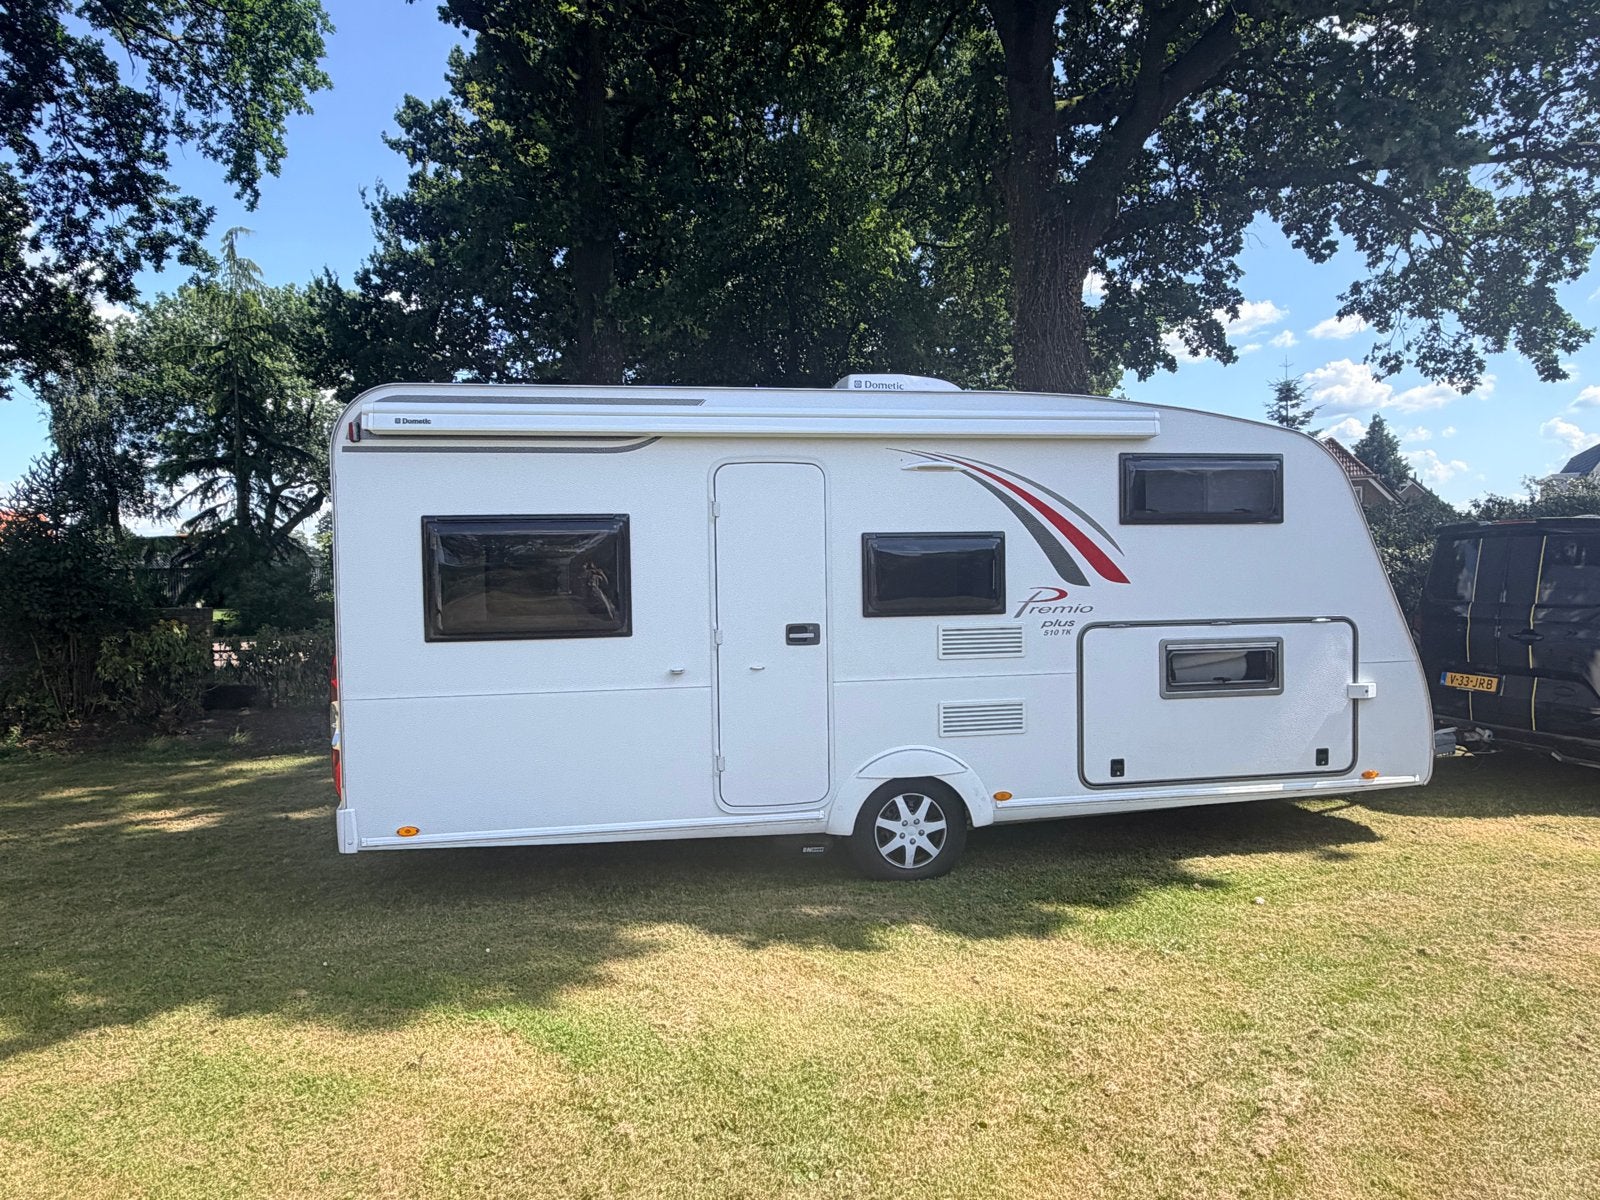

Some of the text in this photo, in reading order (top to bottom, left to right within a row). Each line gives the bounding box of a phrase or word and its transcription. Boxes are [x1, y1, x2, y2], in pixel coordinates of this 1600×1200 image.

[864, 380, 904, 390] Dometic
[1013, 586, 1094, 618] Premio
[1041, 619, 1075, 629] plus
[1061, 628, 1072, 636] TK
[1450, 674, 1493, 690] V-33-JRB
